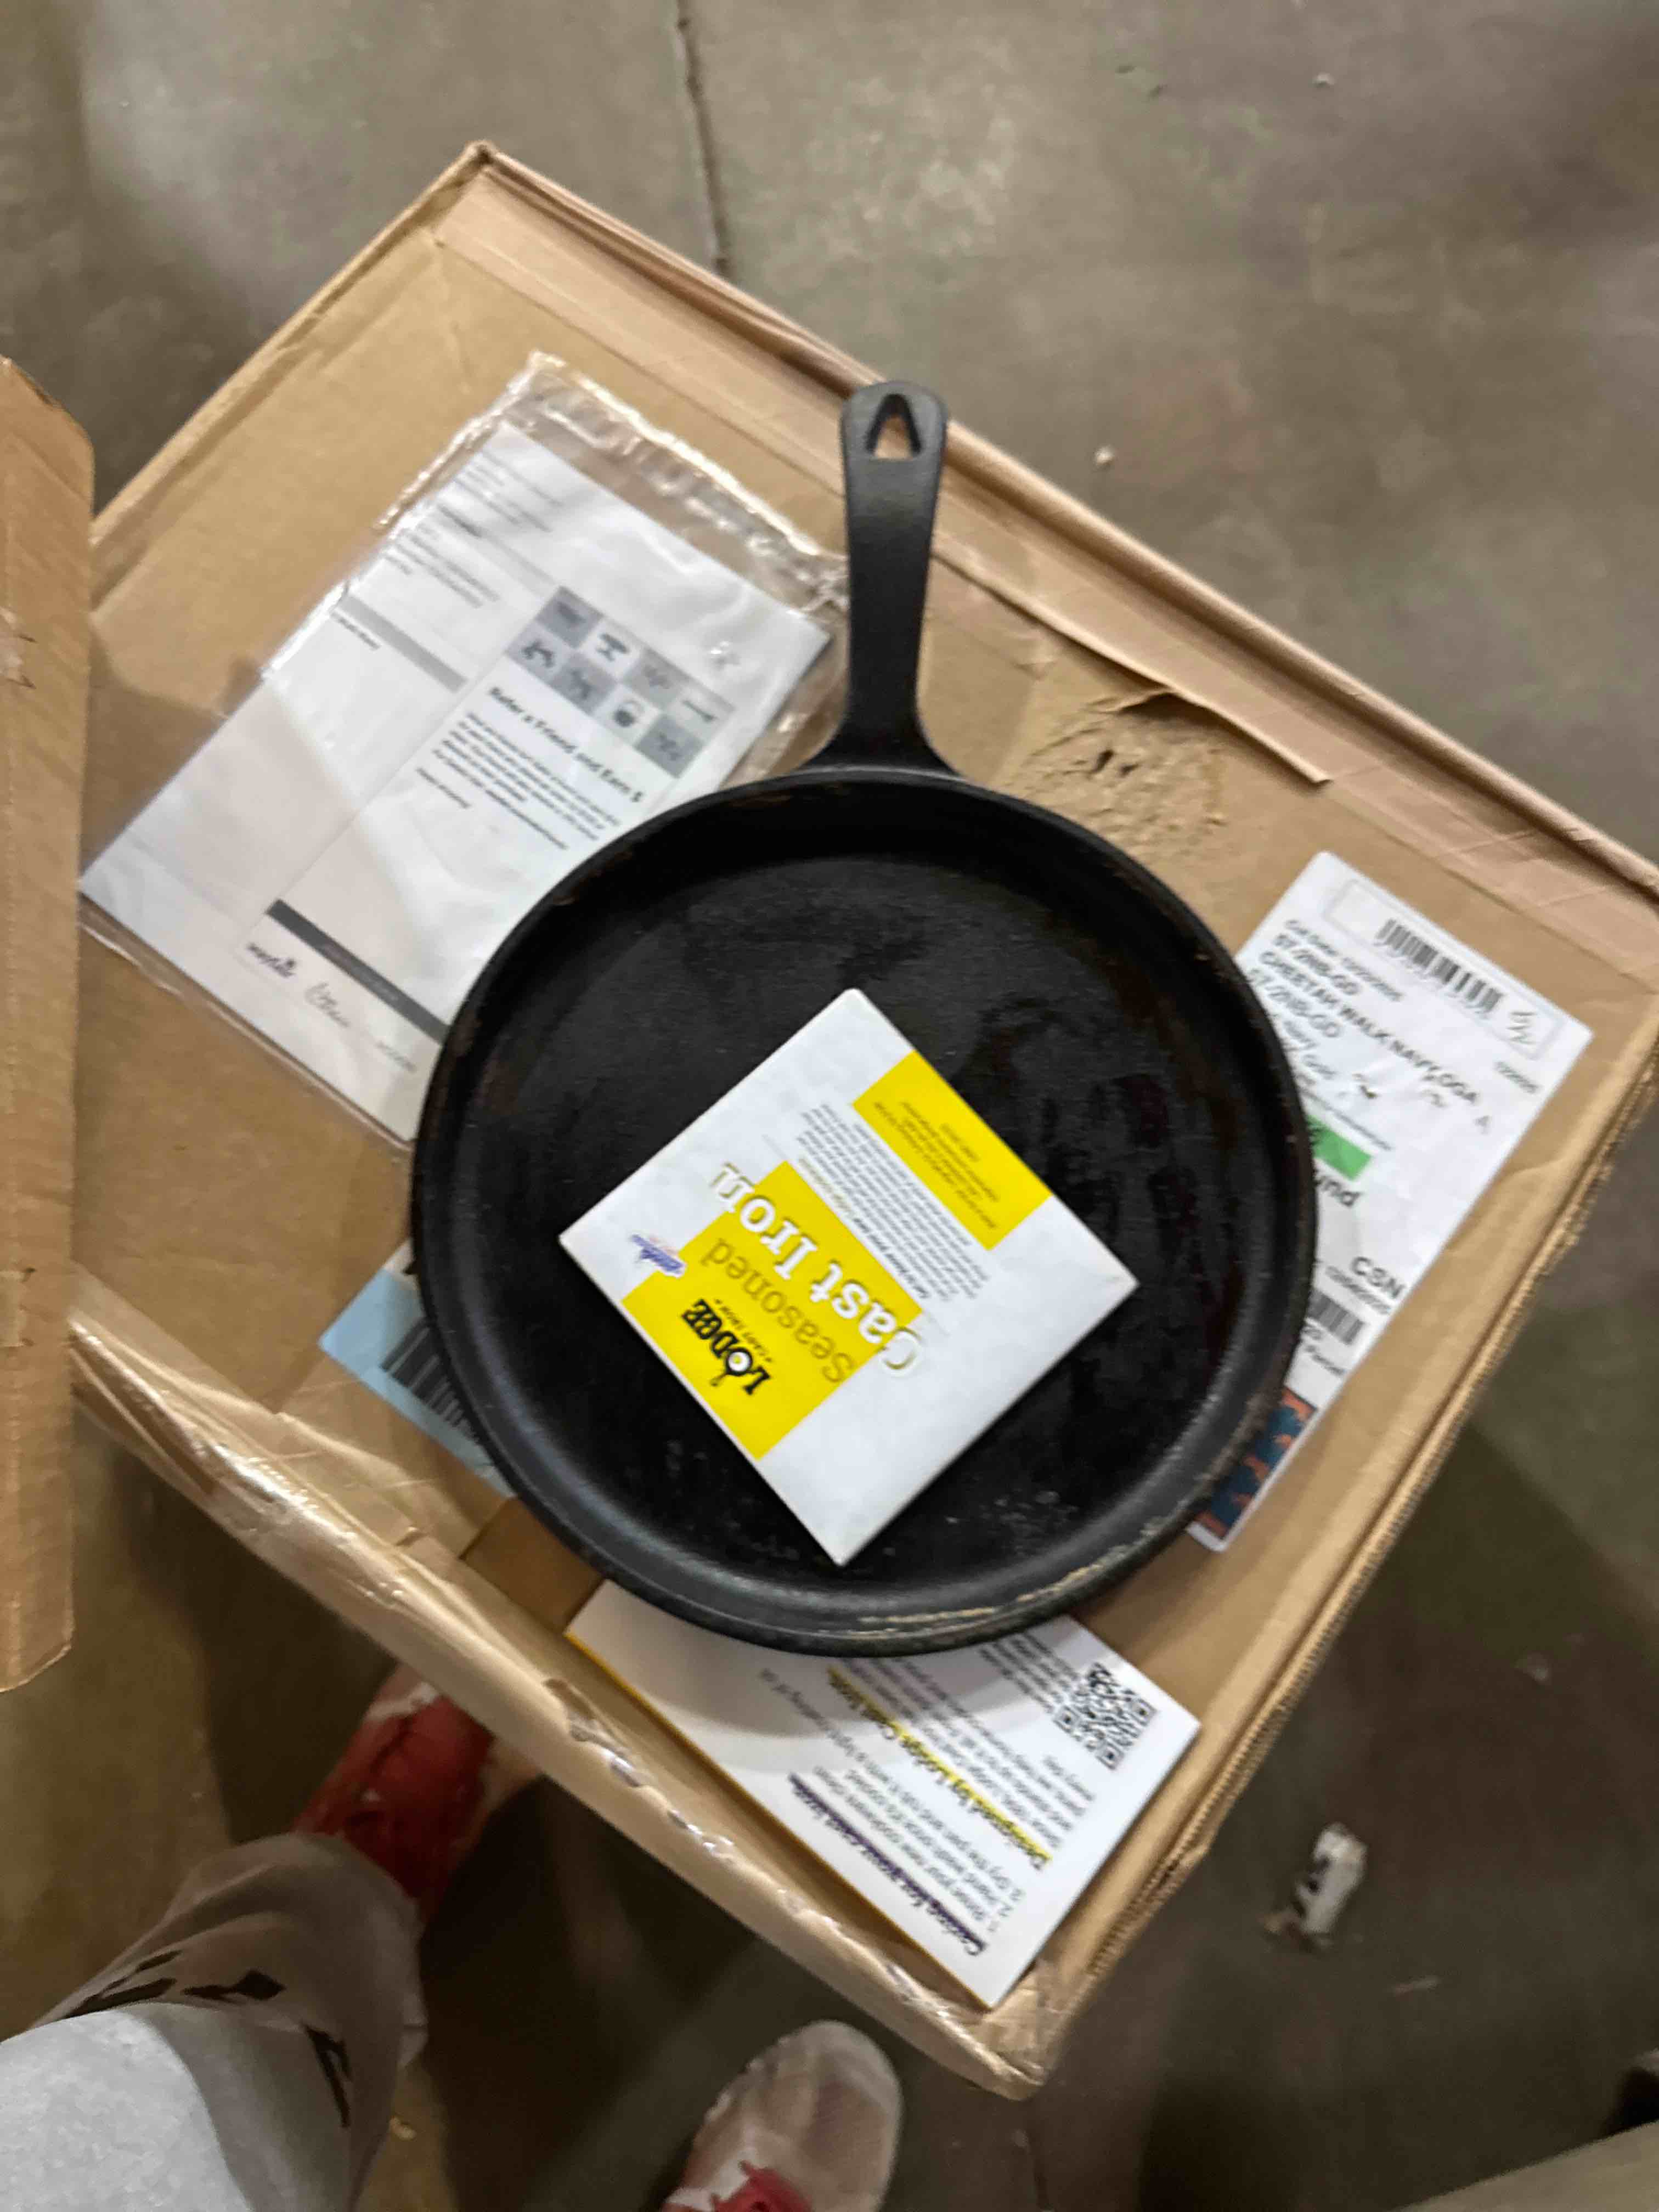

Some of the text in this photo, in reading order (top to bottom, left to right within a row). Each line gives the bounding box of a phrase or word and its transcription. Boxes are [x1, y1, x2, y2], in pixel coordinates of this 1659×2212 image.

[531, 719, 578, 756] Friend
[698, 1161, 822, 1278] Iron
[1348, 1251, 1406, 1301] CSN
[697, 1237, 857, 1387] Seasoned
[800, 1258, 932, 1383] Cast
[679, 1296, 772, 1397] LODGE
[859, 1700, 903, 1744] Cast
[896, 1733, 952, 1787] Lodge
[945, 1776, 974, 1807] by
[822, 1809, 864, 1851] cast
[843, 1790, 903, 1848] cookware
[916, 1804, 945, 1835] and
[967, 1795, 1049, 1873] Designed
[855, 1839, 902, 1886] your
[898, 1839, 928, 1870] new
[938, 1825, 970, 1858] pan
[963, 1847, 990, 1875] the
[896, 1875, 928, 1908] for
[921, 1860, 955, 1894] your
[983, 1864, 1011, 1894] Dry
